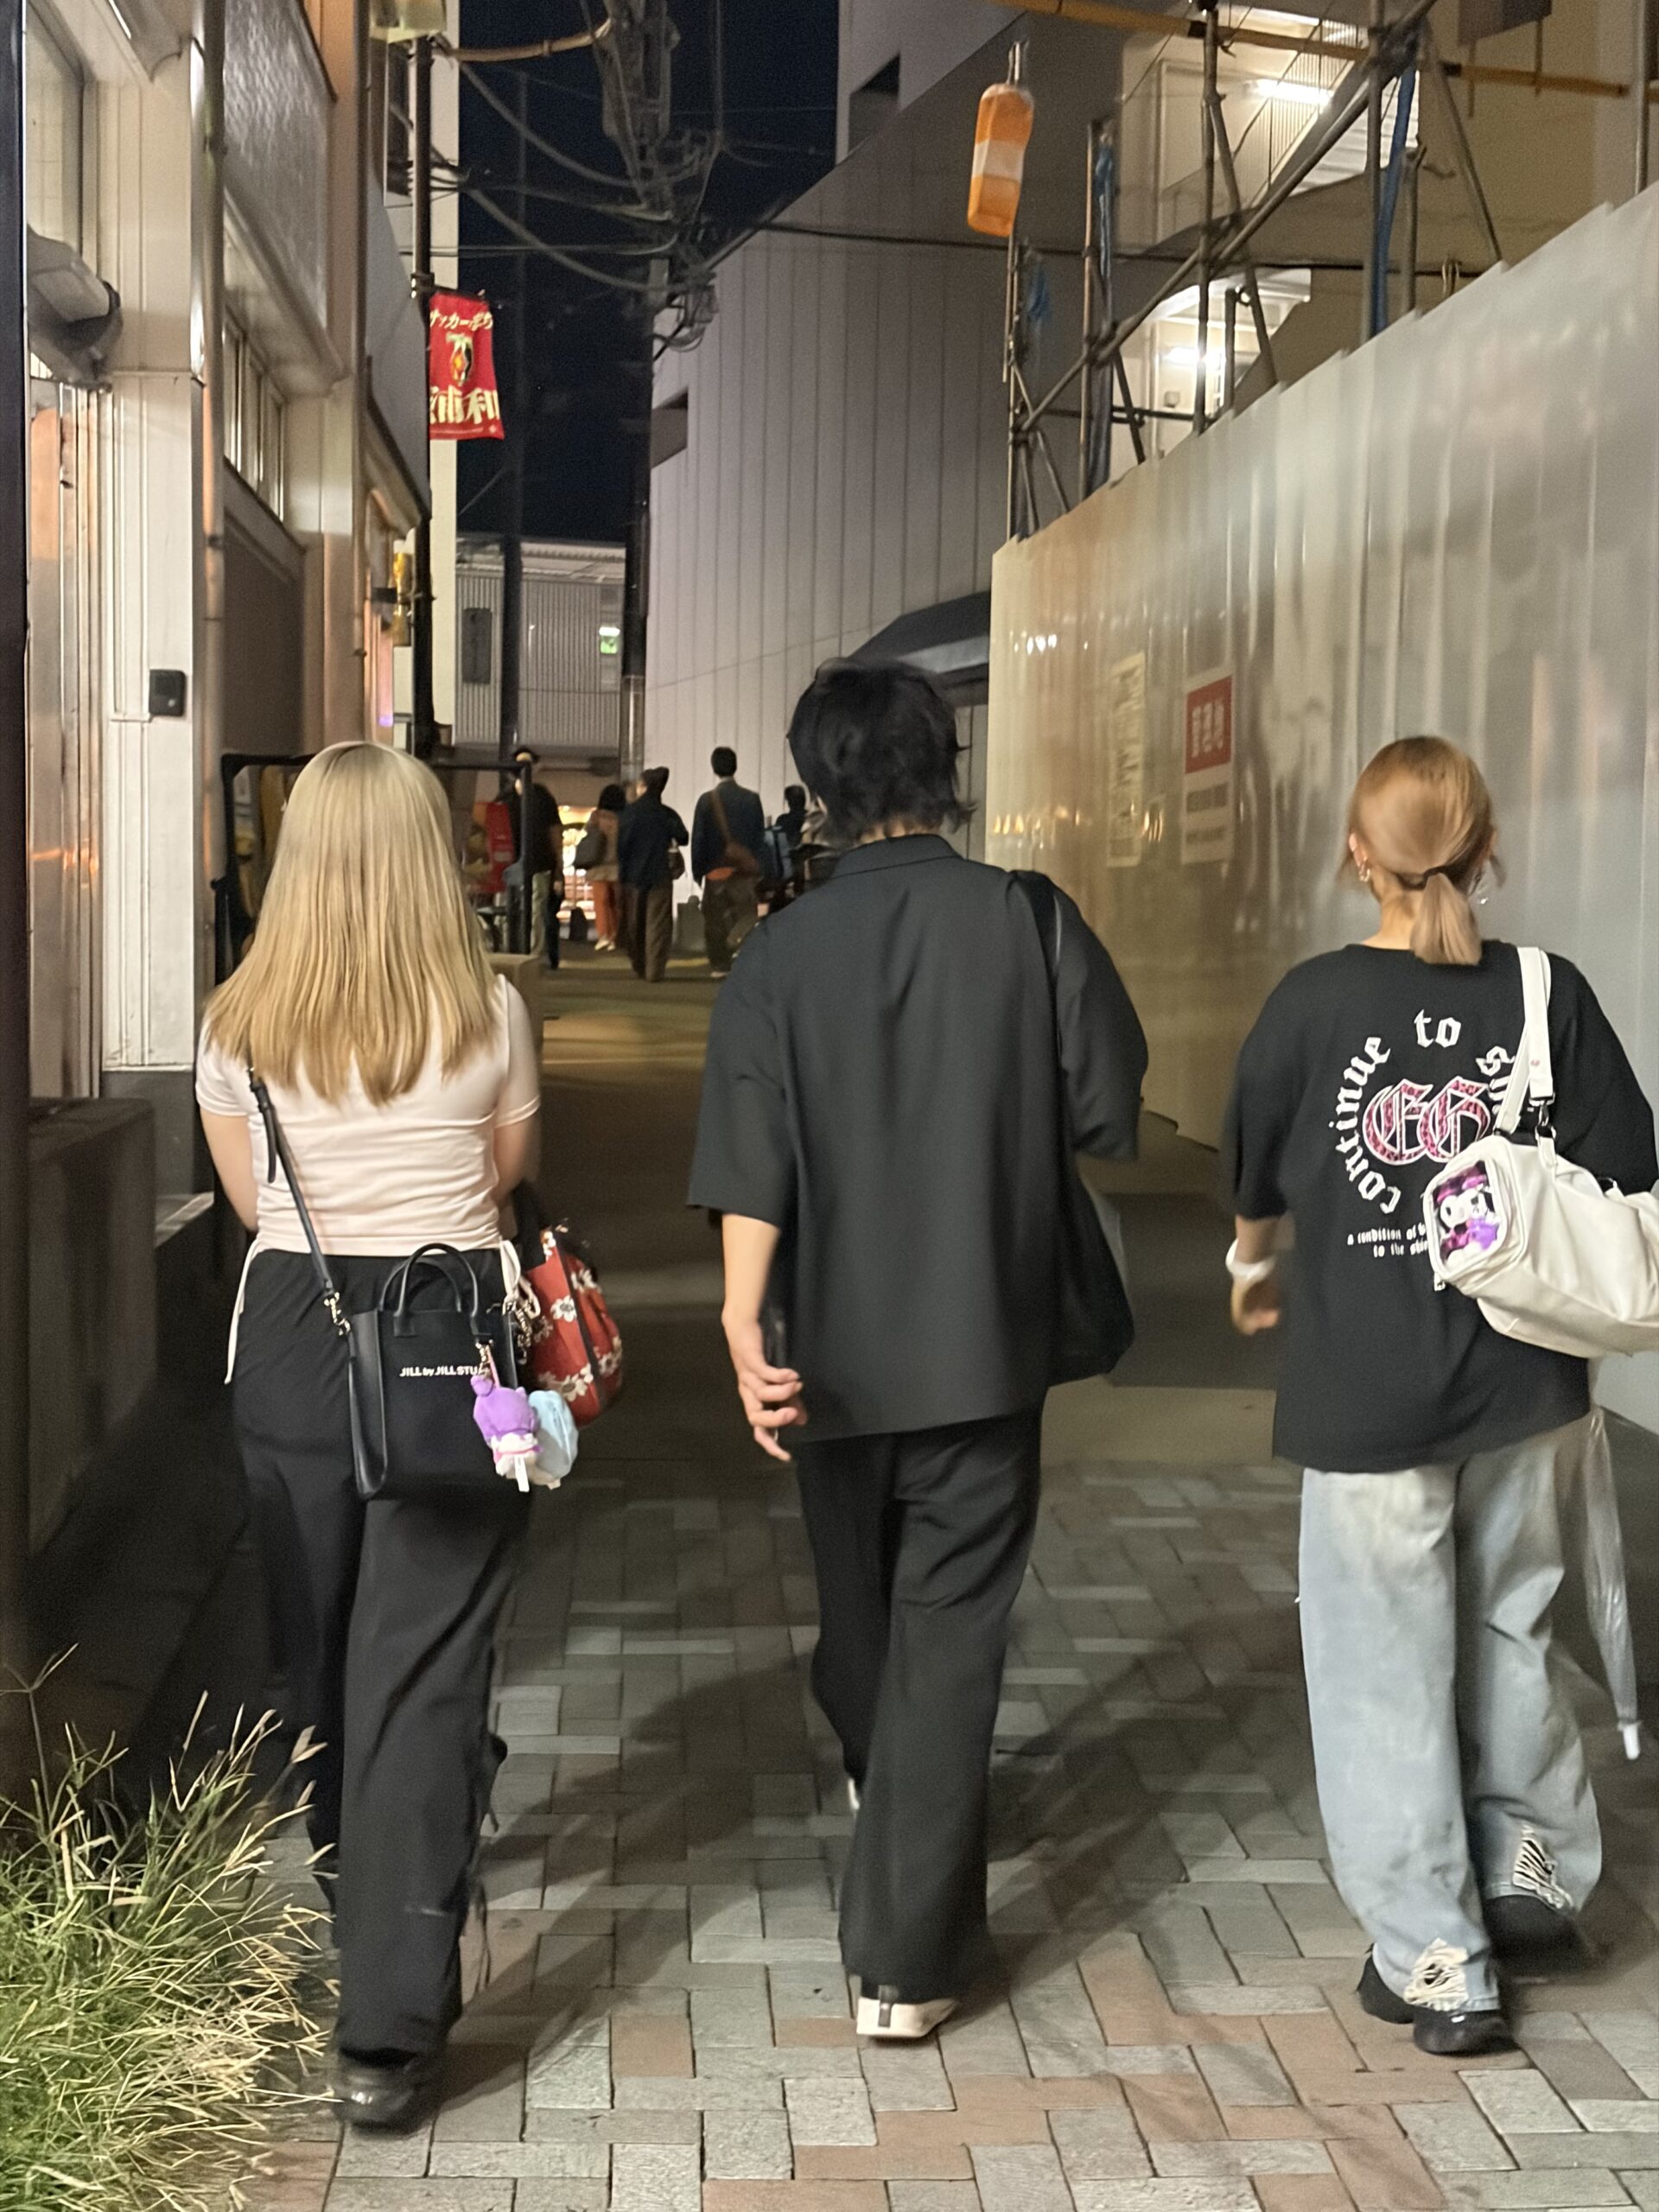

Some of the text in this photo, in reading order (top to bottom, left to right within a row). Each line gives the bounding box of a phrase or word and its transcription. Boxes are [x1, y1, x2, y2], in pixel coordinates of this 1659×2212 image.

[1414, 1009, 1461, 1048] to
[399, 1366, 422, 1377] JILL
[423, 1368, 434, 1376] by
